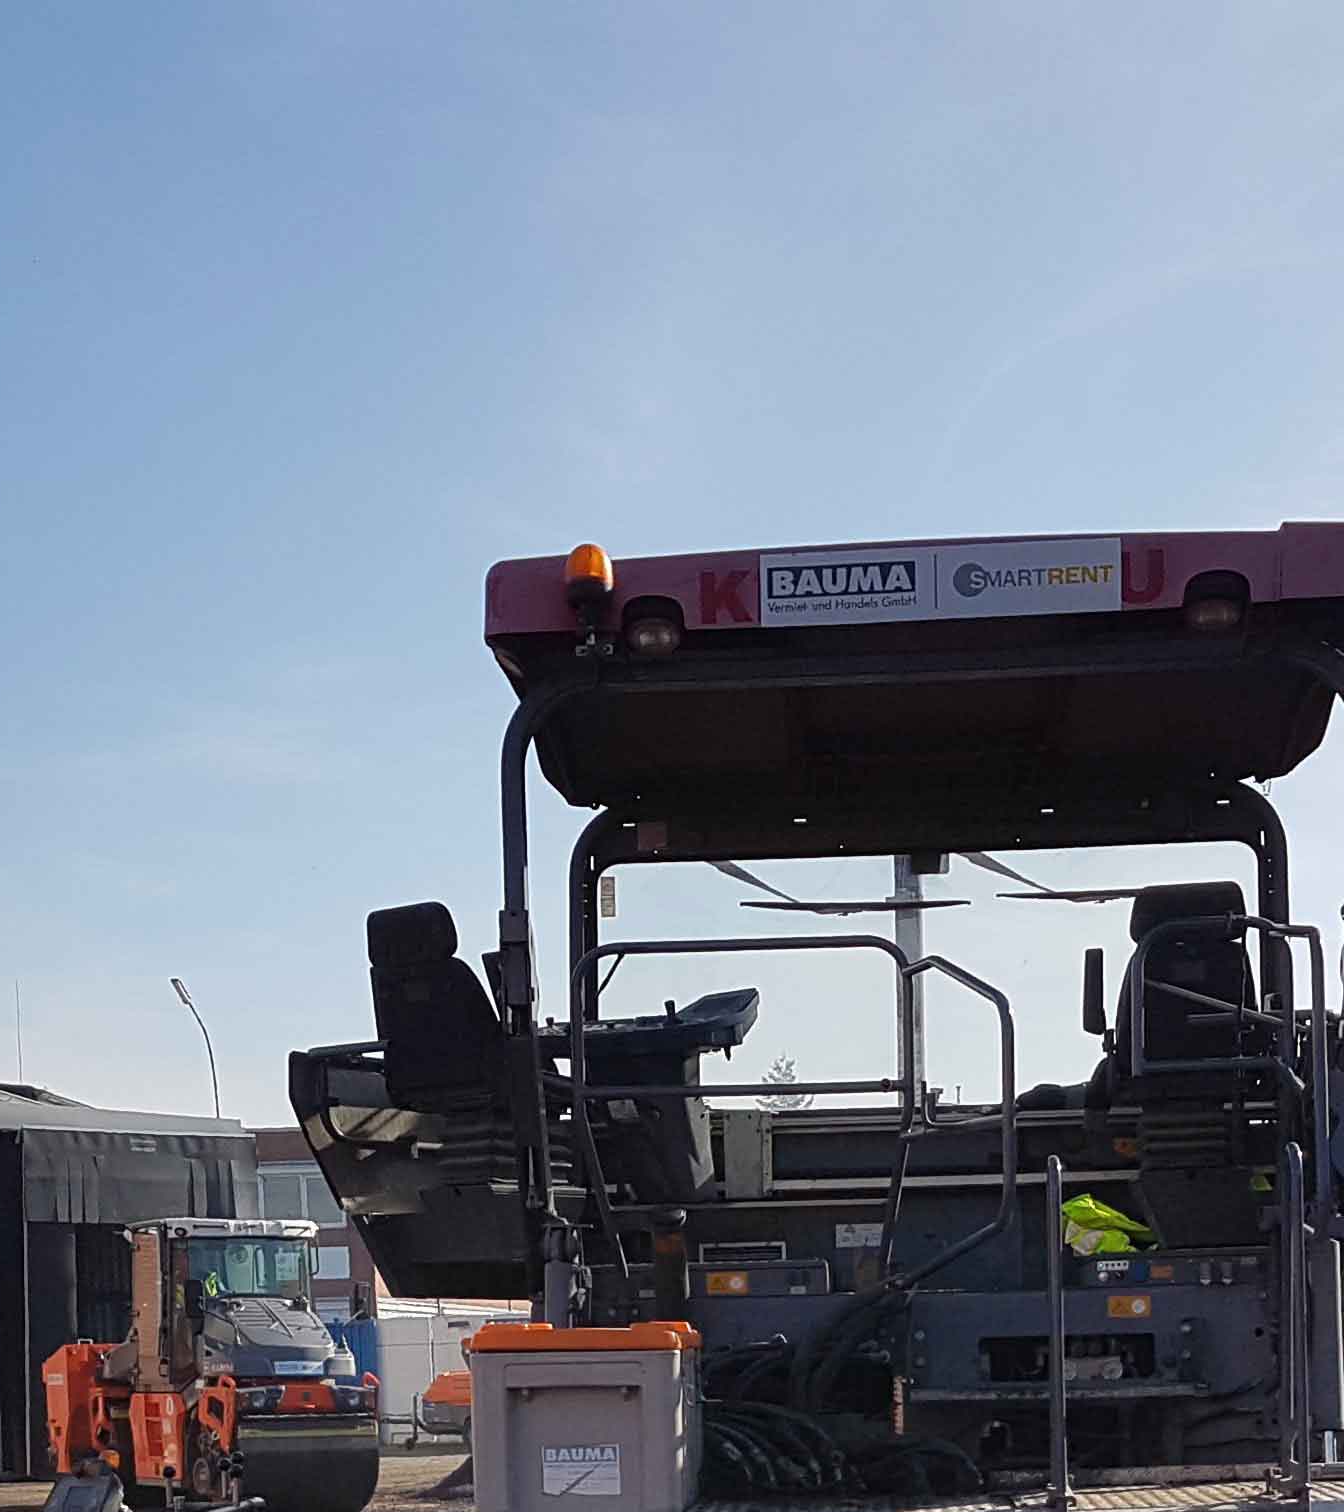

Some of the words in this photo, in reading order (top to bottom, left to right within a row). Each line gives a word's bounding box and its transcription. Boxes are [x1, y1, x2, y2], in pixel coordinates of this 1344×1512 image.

[771, 564, 913, 597] BAUMA
[969, 564, 1113, 589] SMARTRENT
[881, 594, 916, 607] GmbH
[545, 1448, 615, 1461] BAUMA
